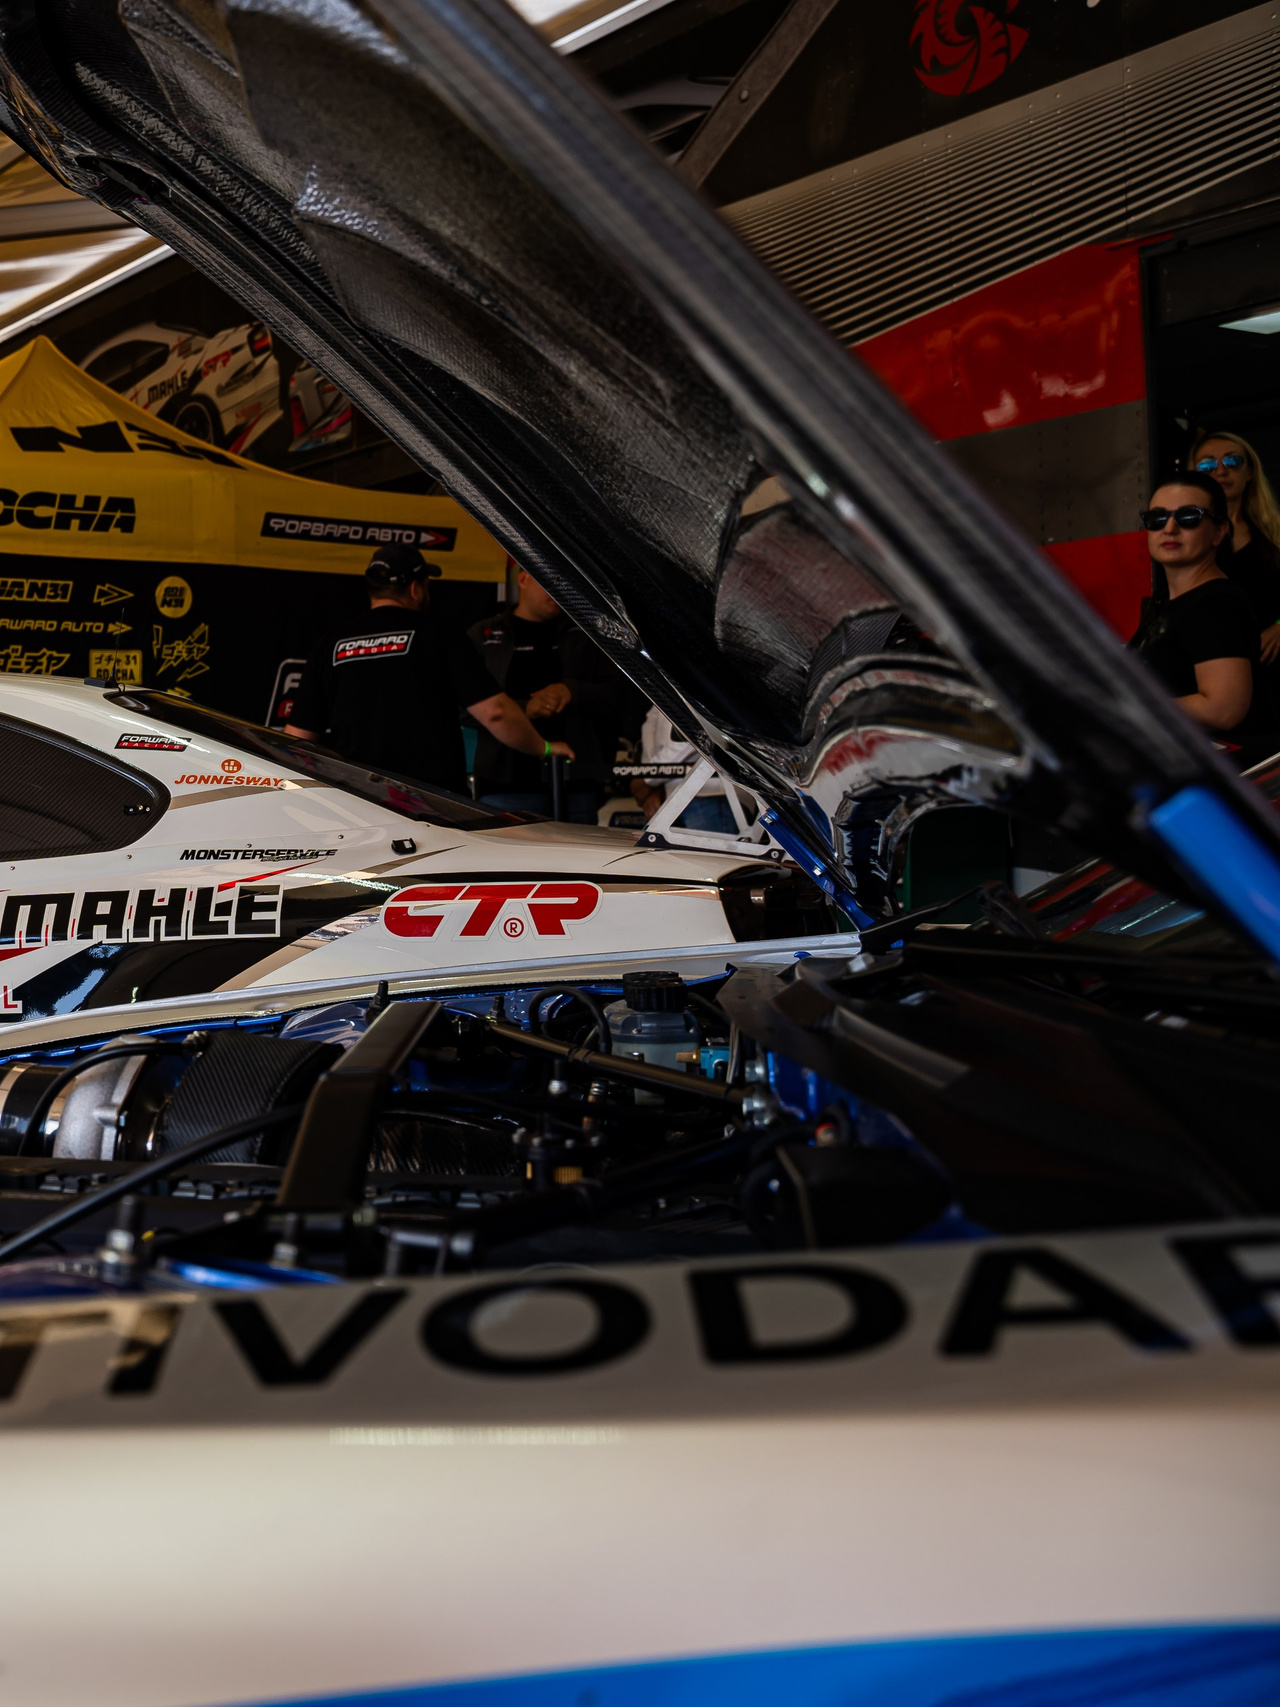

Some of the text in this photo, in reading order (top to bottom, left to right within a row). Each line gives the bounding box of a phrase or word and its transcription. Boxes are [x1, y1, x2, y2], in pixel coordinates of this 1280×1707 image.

[270, 518, 416, 544] ФОРВАРД АВТО
[60, 621, 104, 634] AUTO
[338, 635, 408, 652] FORWARD
[346, 644, 398, 657] MEDIA
[121, 735, 188, 745] FORWARD
[122, 741, 180, 750] RACING
[175, 774, 284, 787] JONNESWAY
[180, 848, 338, 861] MONSTERSERVICE
